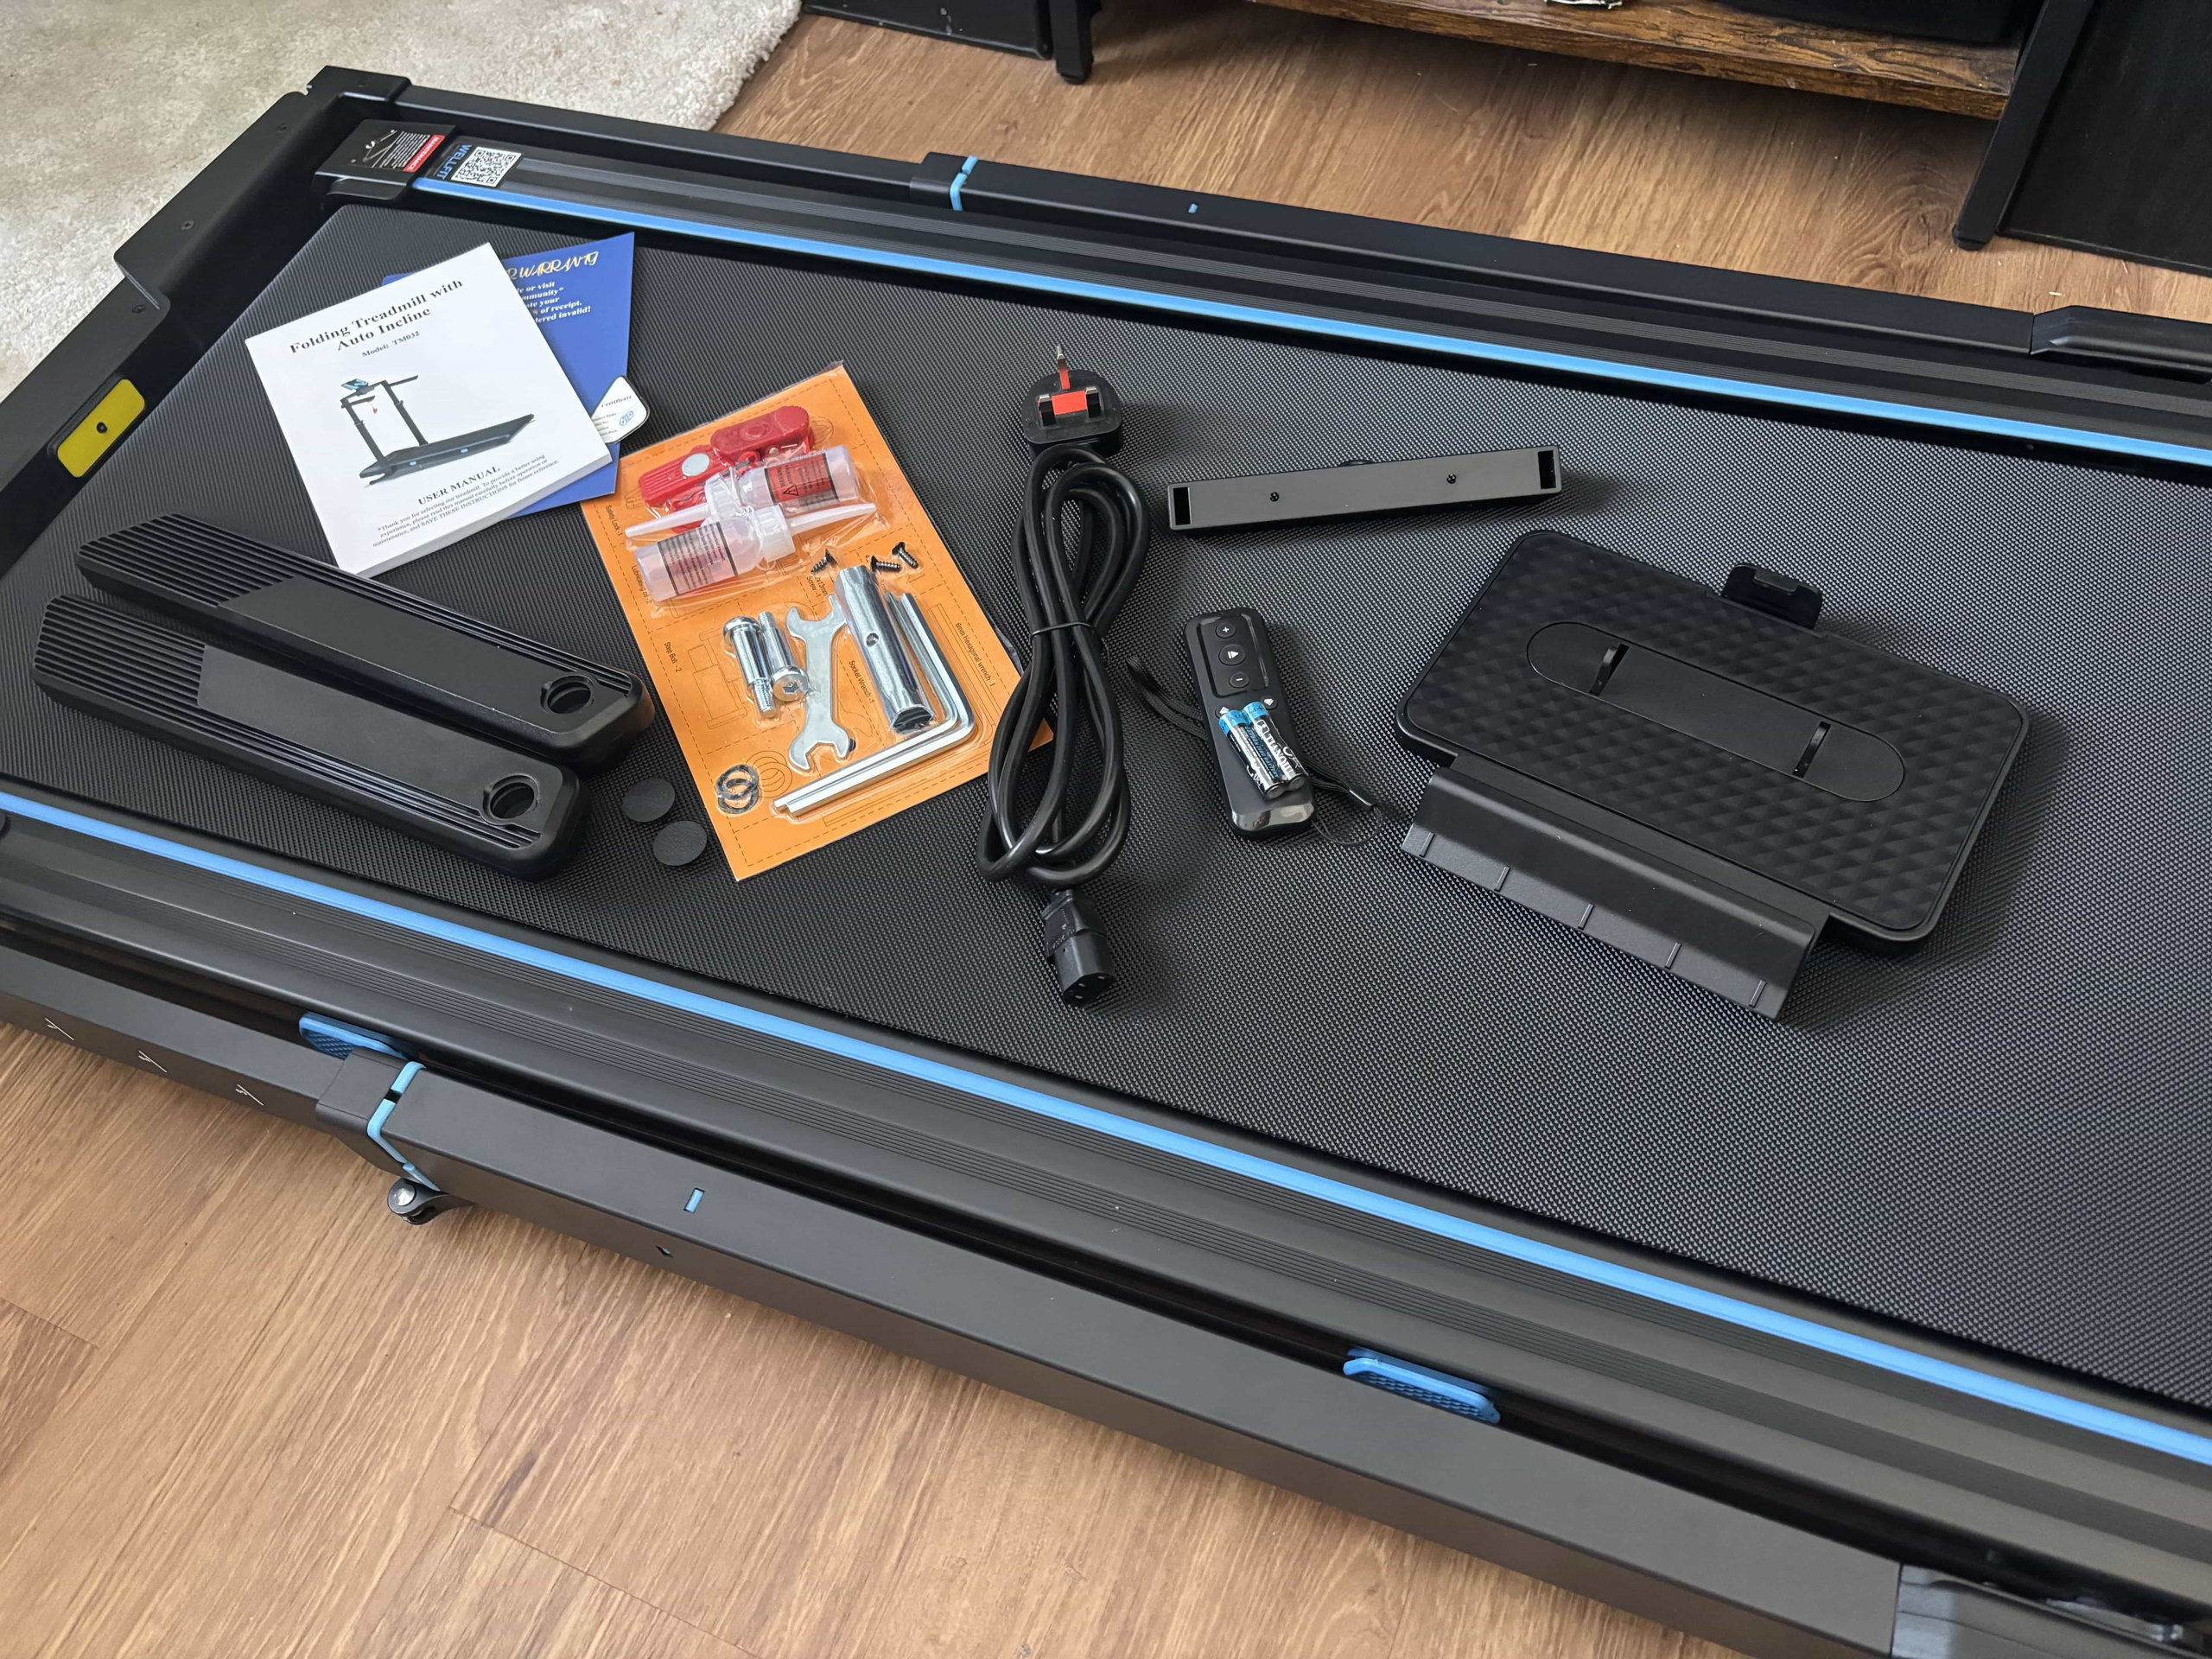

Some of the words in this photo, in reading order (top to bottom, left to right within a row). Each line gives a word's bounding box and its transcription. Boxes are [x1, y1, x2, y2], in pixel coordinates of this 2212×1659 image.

[437, 145, 472, 180] WELLFIT
[519, 251, 599, 277] WARRANTY
[289, 325, 351, 353] Folding
[352, 294, 427, 329] Treadmill
[430, 280, 462, 300] with
[539, 297, 560, 308] your
[551, 301, 582, 312] receipt.
[559, 306, 591, 318] invalid!
[338, 331, 374, 351] Auto
[378, 307, 431, 334] Incline
[361, 342, 389, 358] Model:
[391, 331, 420, 346] TM032
[400, 515, 411, 524] you
[421, 501, 444, 513] selecting
[490, 472, 510, 485] provide
[515, 461, 530, 472] better
[531, 454, 545, 465] using
[413, 513, 429, 525] please
[430, 508, 442, 518] read
[454, 494, 474, 506] manual
[499, 475, 516, 486] before
[418, 488, 448, 505] USER
[449, 467, 500, 492] MANUAL
[422, 516, 438, 526] SAVE
[440, 507, 460, 519] THESE
[461, 486, 508, 510] INSTRUCTIONS
[606, 505, 614, 519] Safety
[632, 565, 645, 591] Lubricating
[807, 575, 817, 590] Screw
[956, 622, 965, 636] 6mm
[963, 635, 982, 662] Hexagonal
[978, 662, 991, 681] wrench
[849, 660, 861, 677] Socket
[858, 677, 871, 697] Wrench
